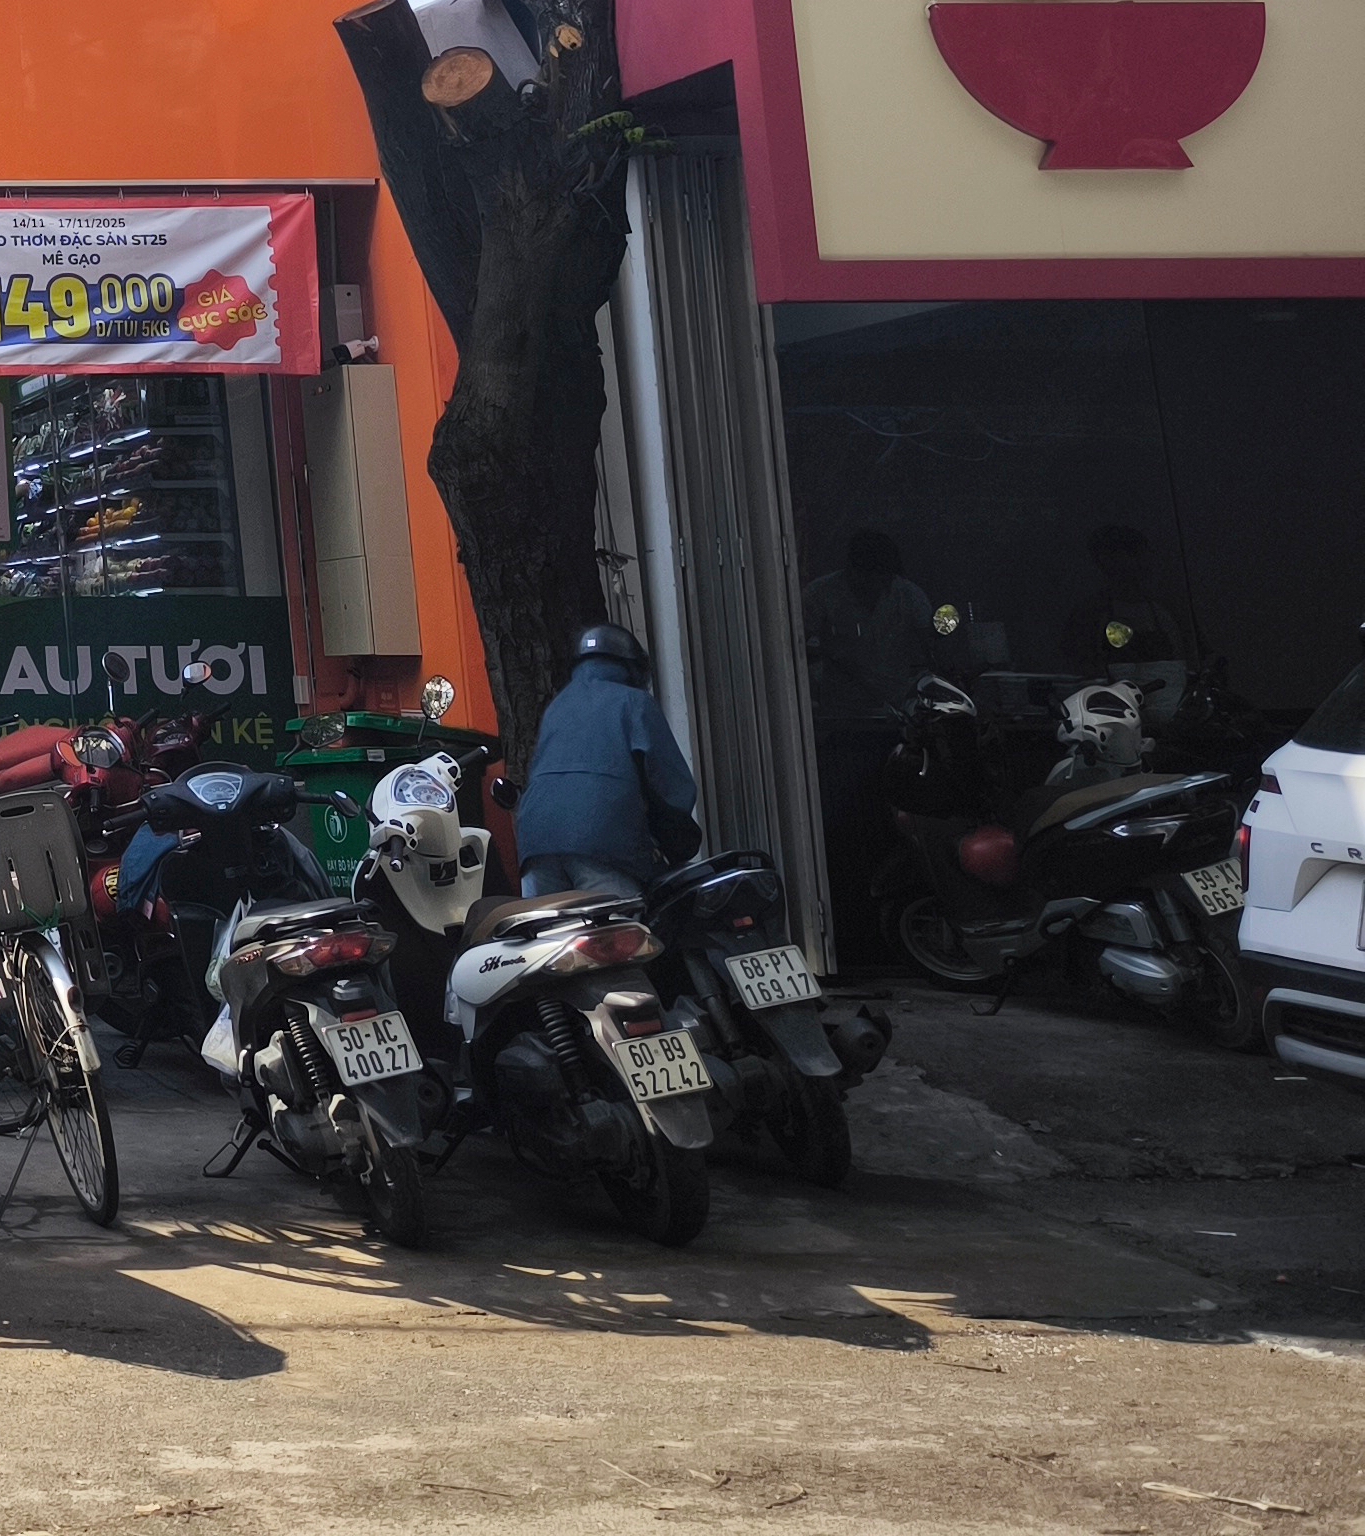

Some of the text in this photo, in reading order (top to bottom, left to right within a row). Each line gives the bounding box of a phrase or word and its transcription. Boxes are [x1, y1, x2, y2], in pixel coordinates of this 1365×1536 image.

[13, 217, 126, 228] 14/11 17/11/2025
[11, 234, 56, 247] THƠM
[60, 232, 93, 249] ĐẶC
[96, 231, 127, 245] SẢN
[131, 234, 167, 245] ST25
[42, 250, 101, 268] MÊ GẠO
[197, 284, 235, 307] GIÁ
[96, 318, 170, 337] Đ/TÚI 5KG
[178, 298, 269, 335] CỰC SỐC
[108, 639, 268, 695] TƯƠI
[234, 712, 275, 751] KỆ
[1192, 862, 1241, 890] 59-X1
[745, 972, 811, 1005] 169.17
[337, 1019, 398, 1052] 50-AC
[344, 1044, 410, 1080] 400.27
[631, 1061, 707, 1097] 522.42
